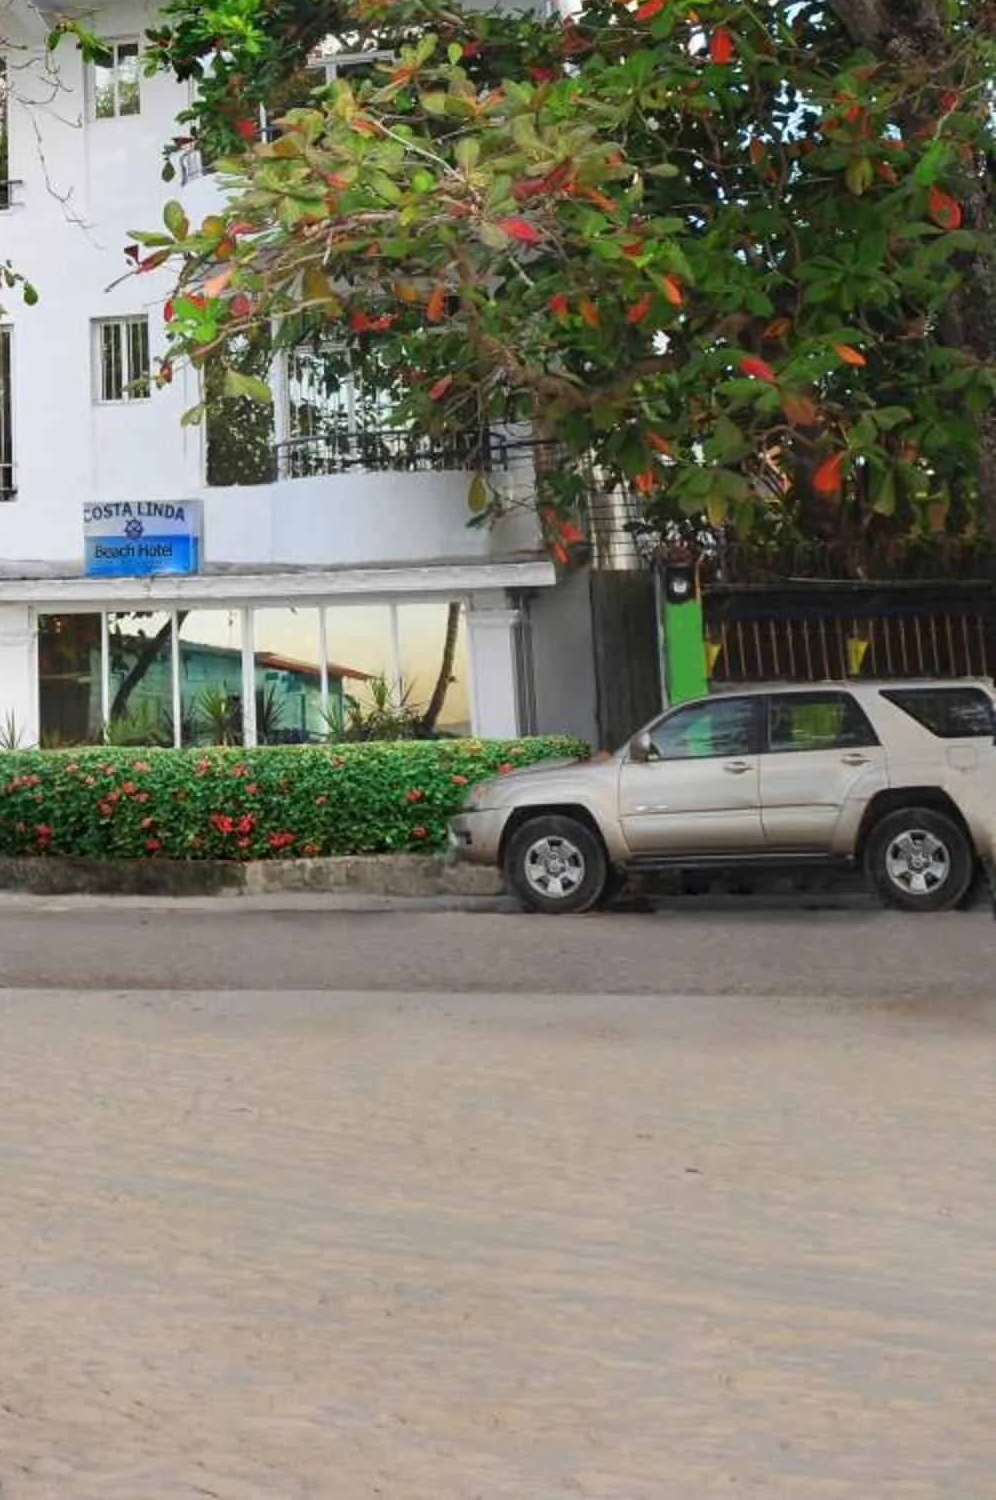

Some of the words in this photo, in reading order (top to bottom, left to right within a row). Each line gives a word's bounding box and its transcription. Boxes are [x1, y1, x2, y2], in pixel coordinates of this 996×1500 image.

[84, 501, 132, 523] COSTA
[137, 501, 185, 522] LINDA
[94, 543, 135, 558] Beach
[139, 542, 173, 557] Hotel
